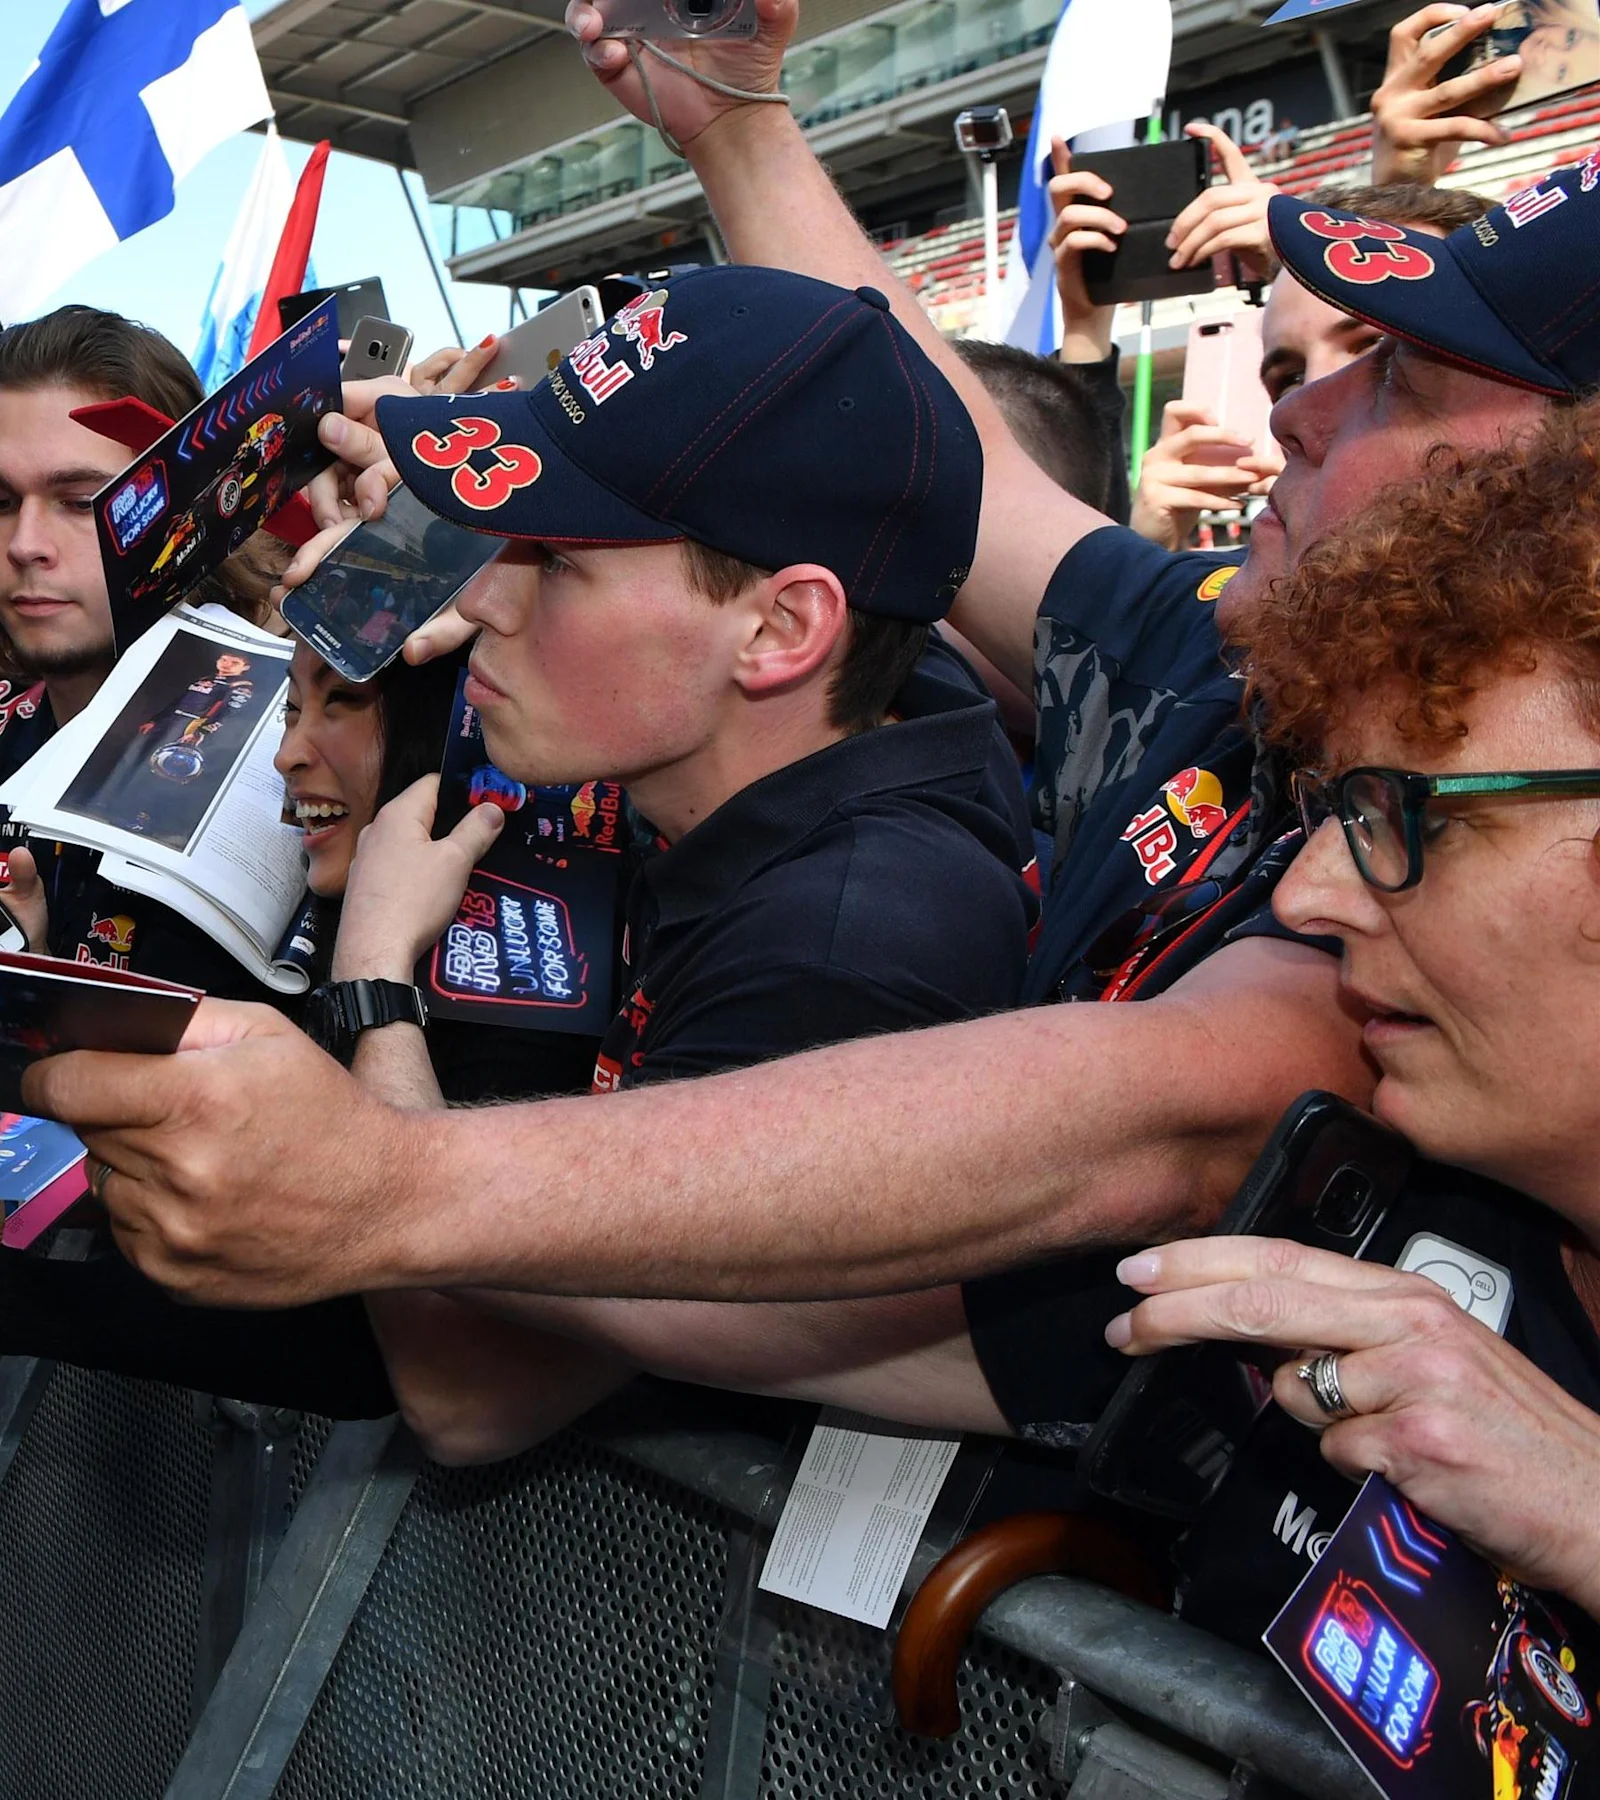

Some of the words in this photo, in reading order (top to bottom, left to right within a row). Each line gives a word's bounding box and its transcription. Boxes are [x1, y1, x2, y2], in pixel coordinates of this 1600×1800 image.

[1299, 209, 1435, 284] 33
[558, 390, 586, 424] ROSSO
[411, 416, 543, 511] 33
[116, 483, 159, 536] UNLUCKY
[121, 522, 142, 549] FOR
[141, 496, 166, 525] SOME
[1132, 820, 1177, 886] Bu
[500, 895, 539, 995] UNLUCKY
[531, 899, 565, 951] SOME
[540, 948, 572, 999] FOR
[1475, 1279, 1492, 1293] CELL
[1359, 1626, 1399, 1726] UNLUCKY
[1384, 1703, 1412, 1754] FOR
[1400, 1655, 1430, 1713] SOME
